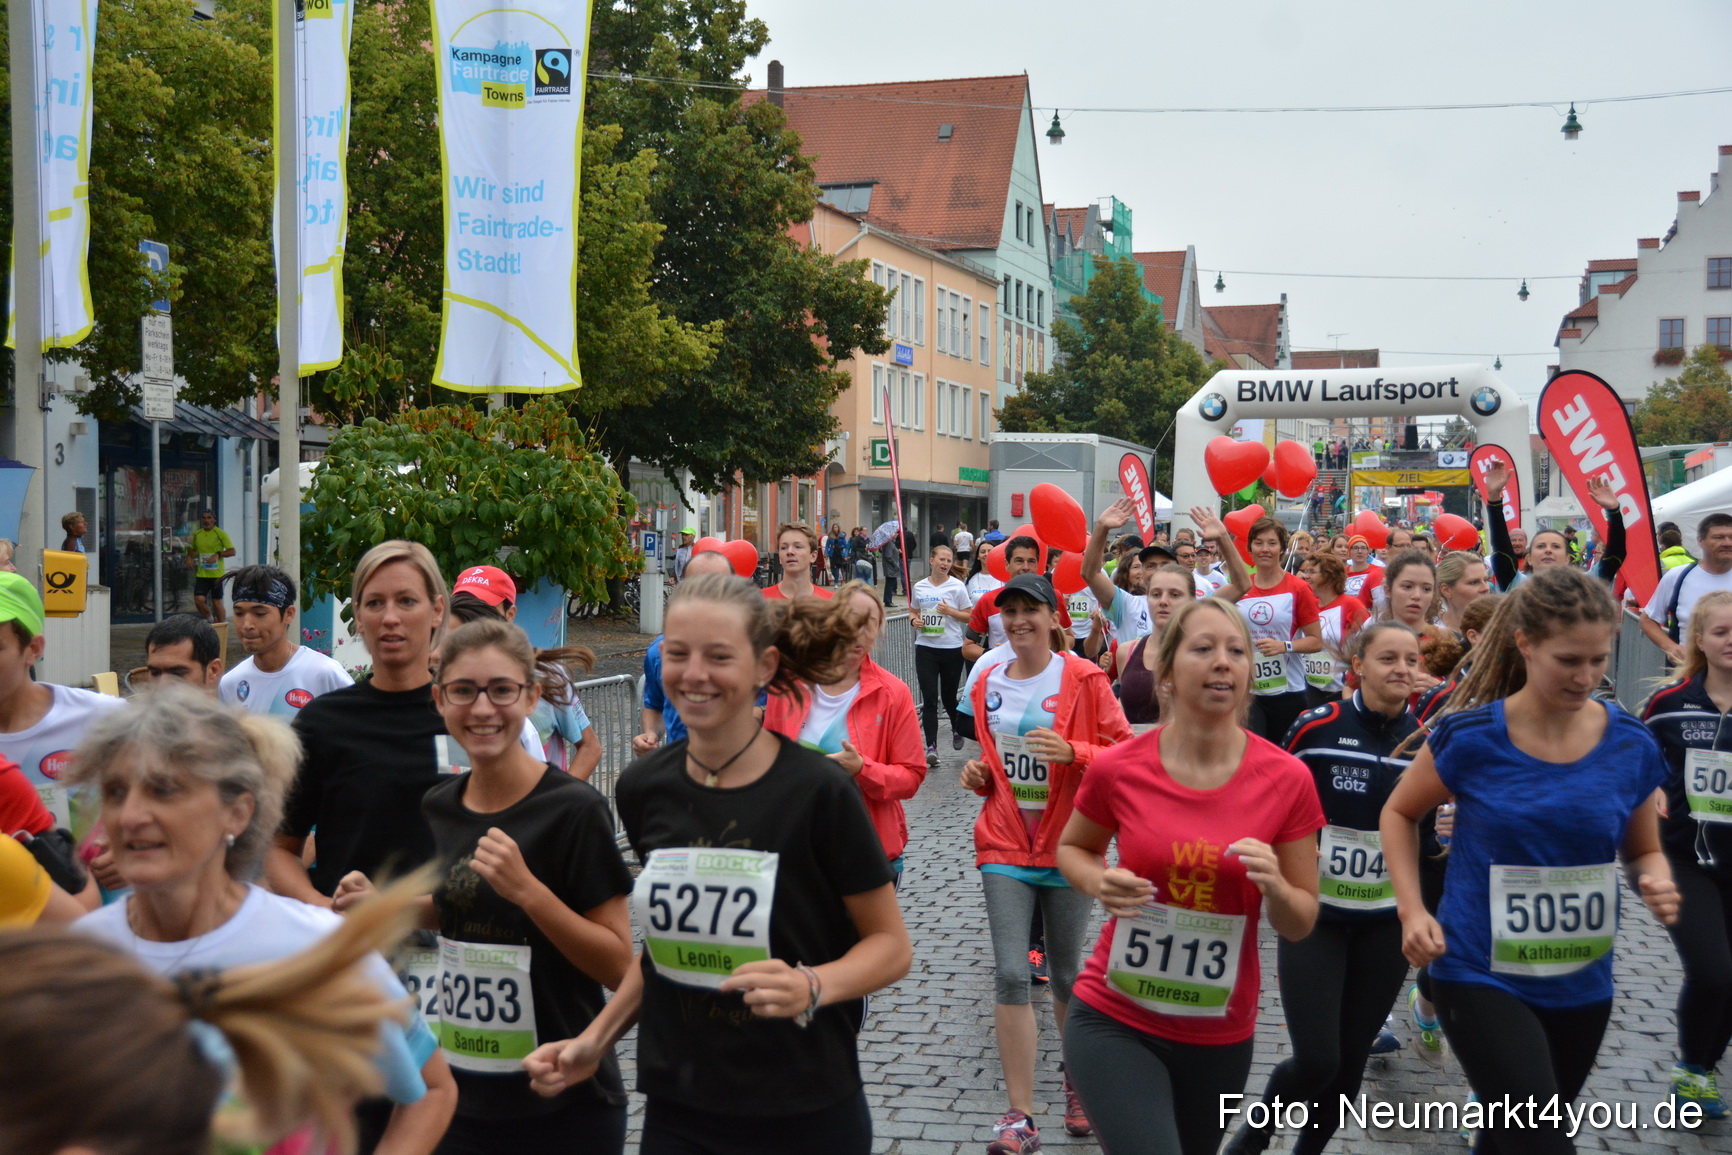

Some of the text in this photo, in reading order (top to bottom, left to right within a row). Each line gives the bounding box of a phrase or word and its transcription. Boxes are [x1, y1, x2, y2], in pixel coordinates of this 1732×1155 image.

[452, 48, 522, 67] Kampagne
[453, 61, 530, 83] Fairtrade
[484, 87, 524, 102] Towns
[453, 176, 544, 204] Wir sind
[458, 212, 563, 239] Fairtrade-
[458, 248, 521, 274] Stadt!
[1237, 377, 1459, 405] BMW Laufsport
[55, 442, 65, 466] 3
[1397, 473, 1424, 483] ZIEL
[1124, 464, 1152, 533] REWE
[646, 536, 654, 548] P
[462, 576, 490, 586] DEKRA
[922, 615, 943, 626] 5007
[1255, 660, 1282, 679] 053
[1305, 660, 1331, 675] 5039
[1338, 736, 1359, 746] JAKO
[1682, 729, 1714, 741] Götz
[47, 758, 70, 772] Her
[1004, 751, 1048, 782] 506
[1332, 776, 1367, 793] Götz
[696, 853, 761, 872] BOCK
[1172, 840, 1220, 869] WE
[1329, 845, 1388, 880] 504
[1337, 883, 1383, 900] Christina
[649, 882, 758, 938] 5272
[1505, 891, 1605, 933] 5050
[1175, 912, 1235, 931] BOCK
[465, 948, 518, 965] BOCK
[677, 946, 733, 971] Leonie
[1125, 927, 1228, 980] 5113
[1518, 944, 1591, 960] Katharina
[442, 970, 522, 1023] 5253
[1137, 979, 1200, 1003] Theresa
[454, 1031, 500, 1054] Sandra
